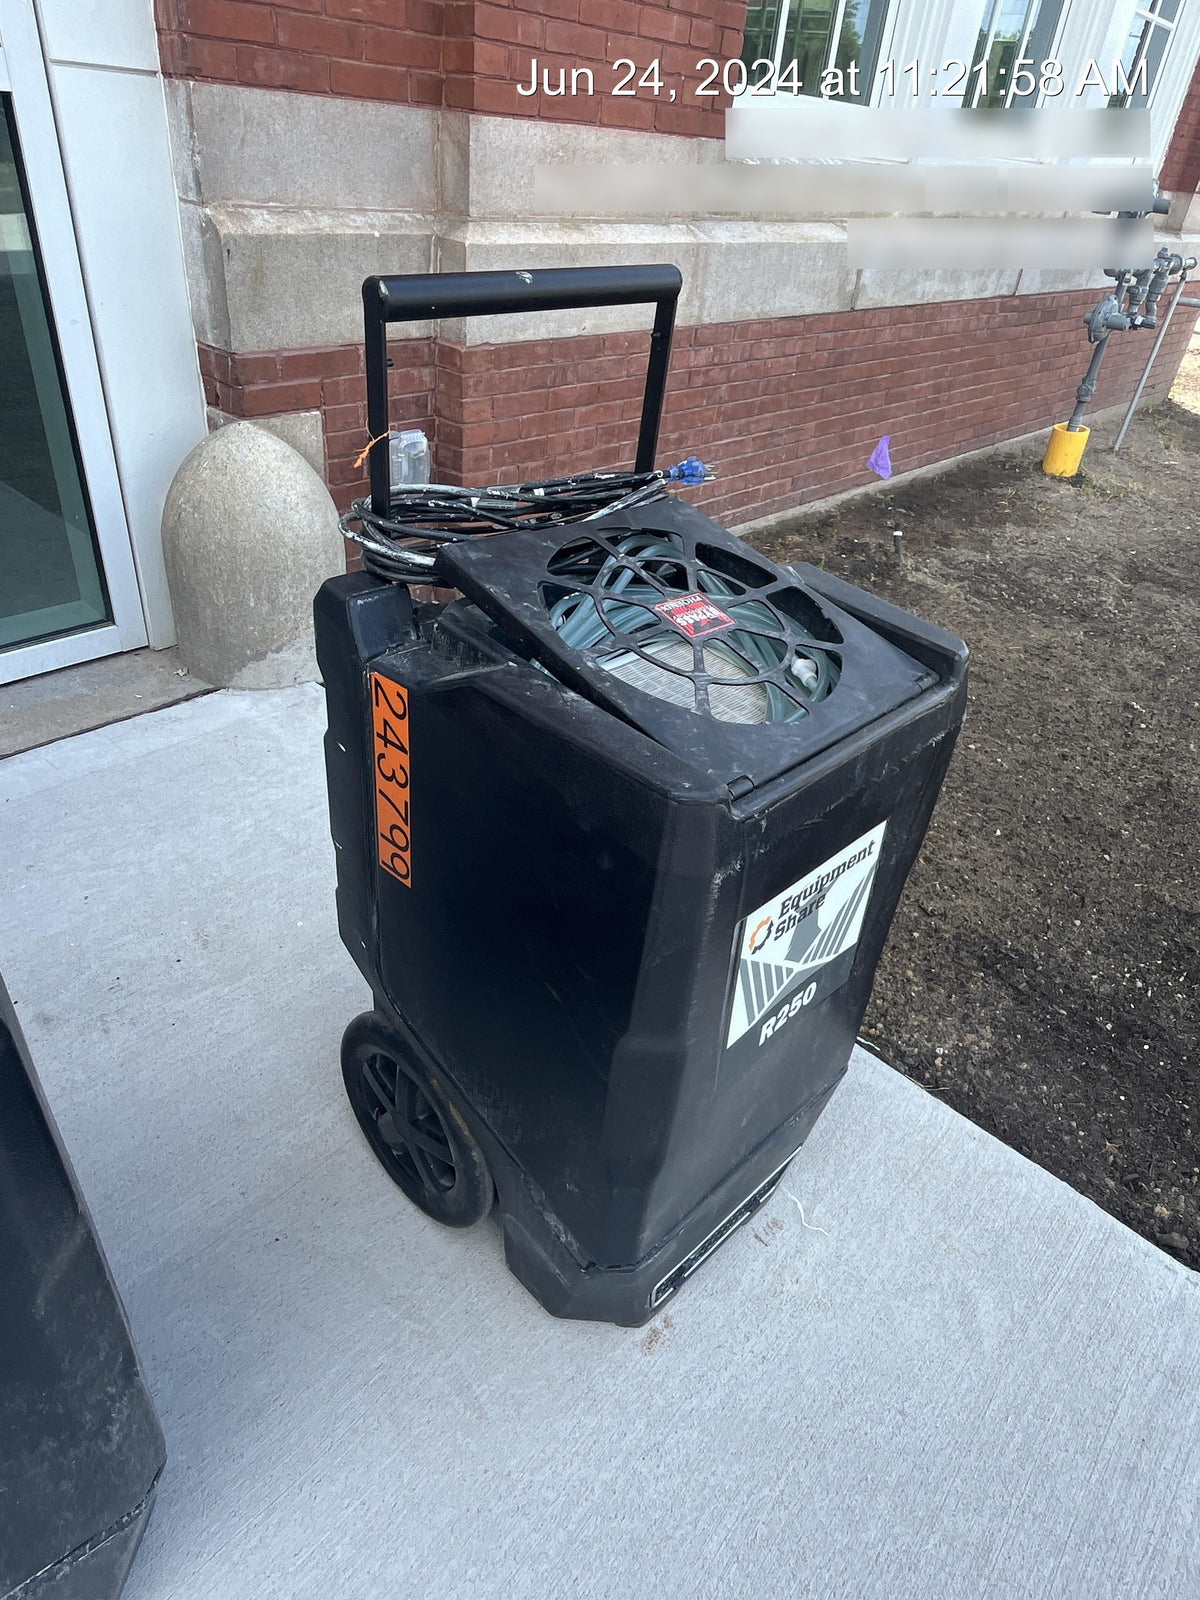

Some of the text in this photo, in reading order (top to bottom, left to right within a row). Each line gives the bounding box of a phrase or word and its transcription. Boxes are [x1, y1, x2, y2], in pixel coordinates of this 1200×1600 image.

[374, 677, 410, 880] 243799
[778, 839, 876, 920] Equipment
[773, 894, 827, 942] Share
[759, 981, 818, 1047] R250
